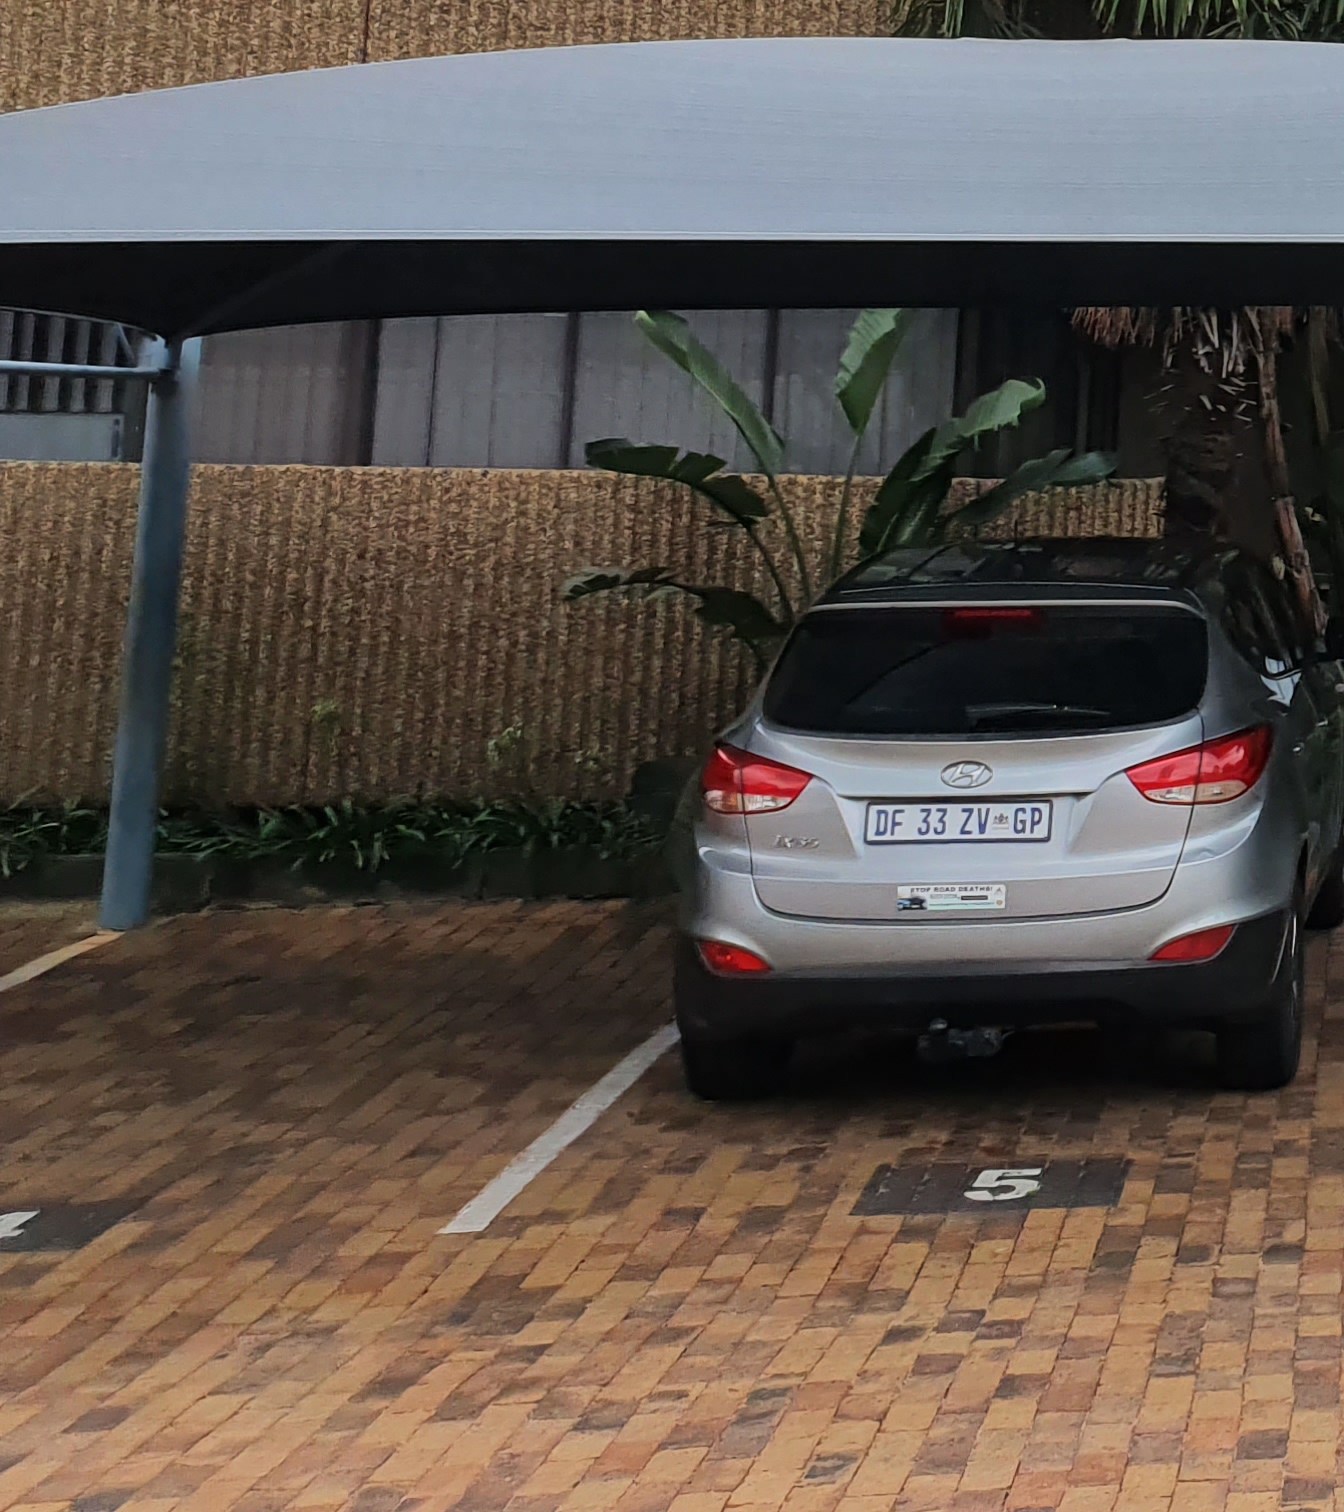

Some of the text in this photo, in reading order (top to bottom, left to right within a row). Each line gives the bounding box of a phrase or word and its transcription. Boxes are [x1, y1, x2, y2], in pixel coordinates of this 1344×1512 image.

[874, 806, 1043, 837] DF 33 ZV GP
[963, 1167, 1042, 1201] 5
